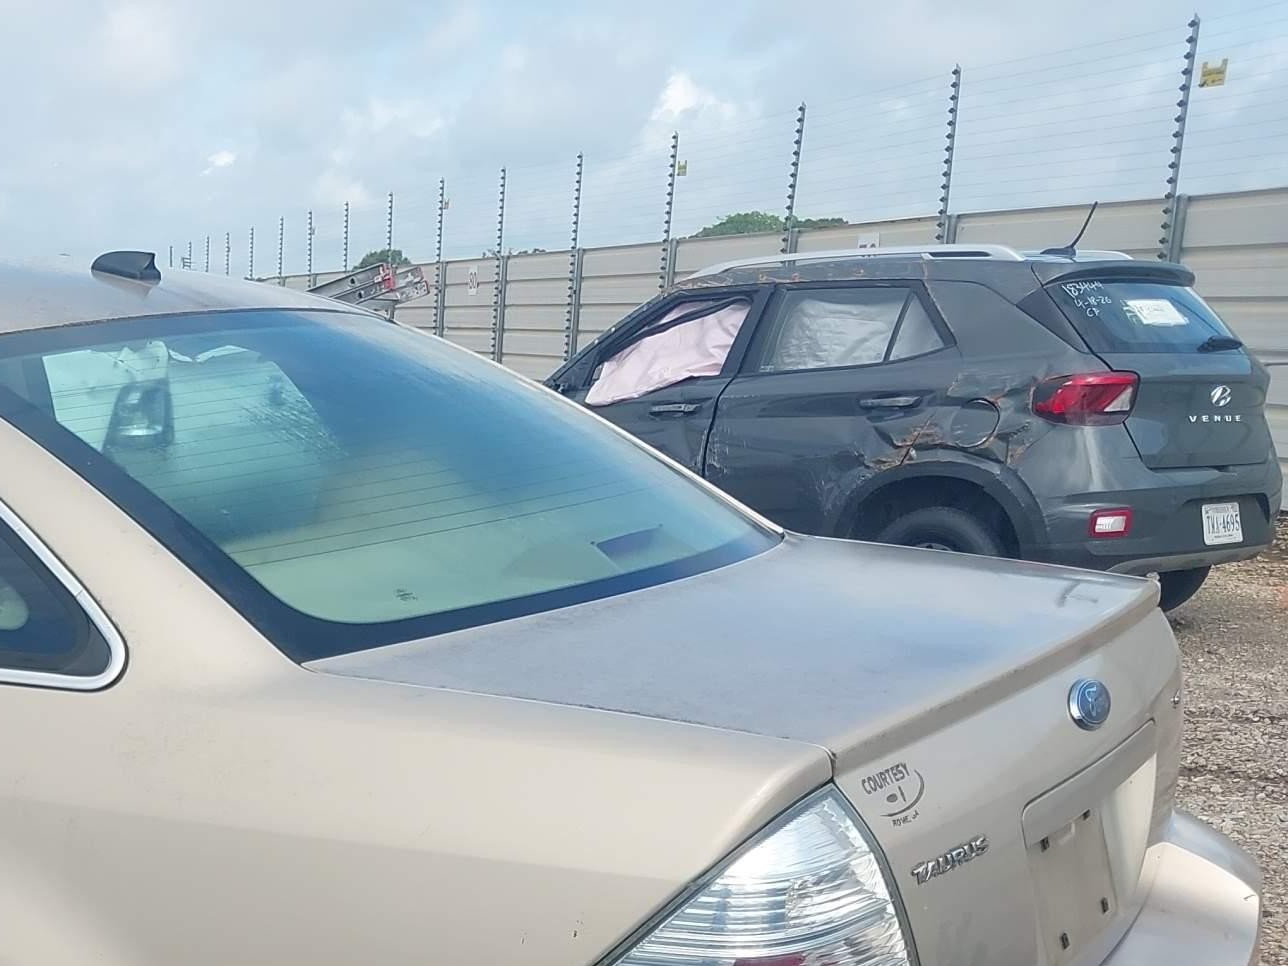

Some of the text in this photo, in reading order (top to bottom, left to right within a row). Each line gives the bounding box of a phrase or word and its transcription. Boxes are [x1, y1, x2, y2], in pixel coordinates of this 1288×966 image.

[1189, 415, 1242, 423] VENUE
[861, 762, 910, 795] COURTESY
[911, 835, 989, 885] TAURUS
